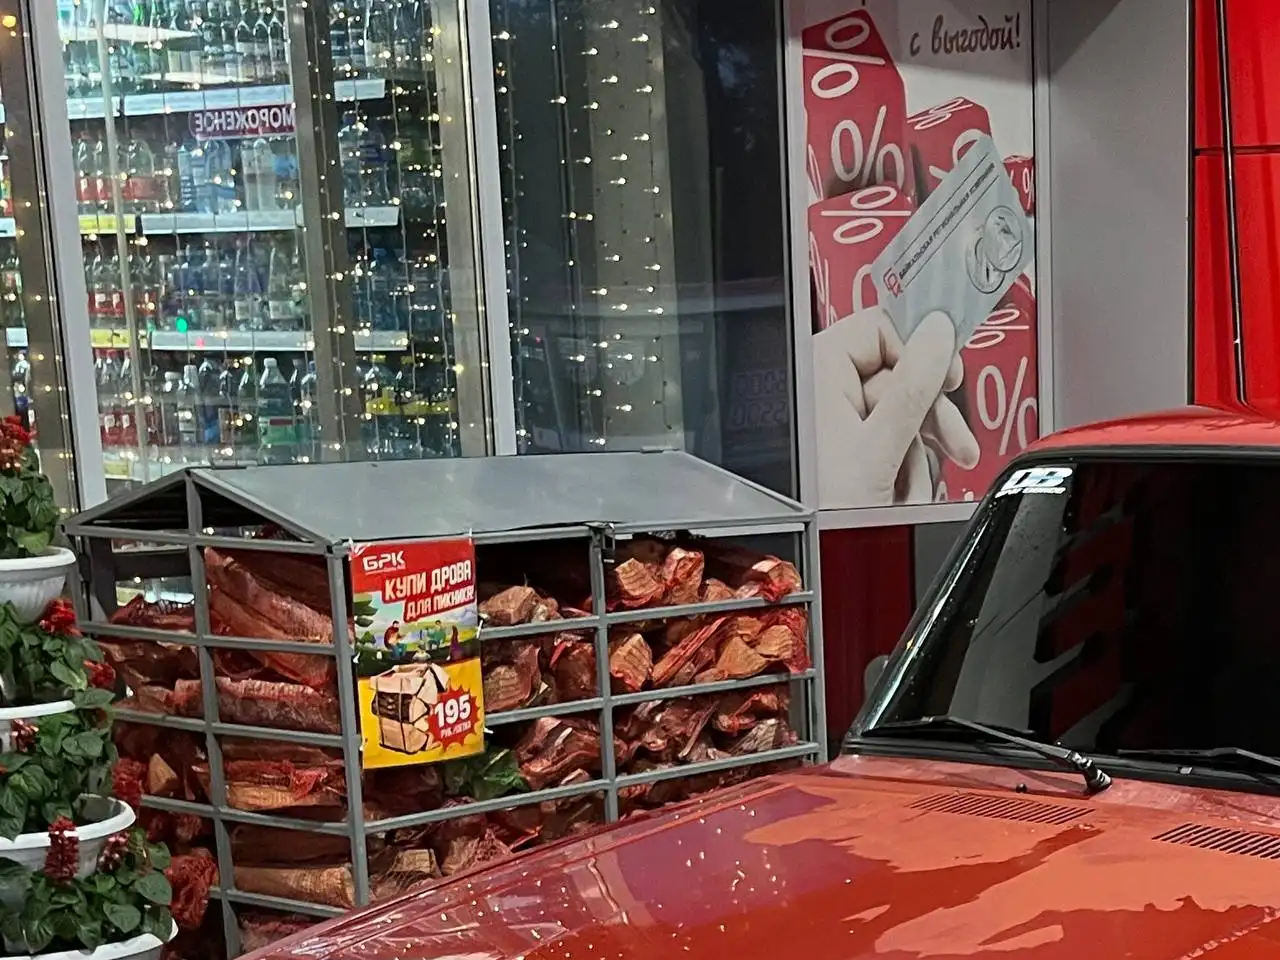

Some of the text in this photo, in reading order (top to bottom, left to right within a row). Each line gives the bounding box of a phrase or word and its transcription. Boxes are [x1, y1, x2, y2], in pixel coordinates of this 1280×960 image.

[909, 12, 1020, 57] с выгодой!
[384, 559, 472, 601] КУПИ ДРОВА
[406, 597, 432, 620] ДЛЯ
[434, 693, 471, 728] 195
